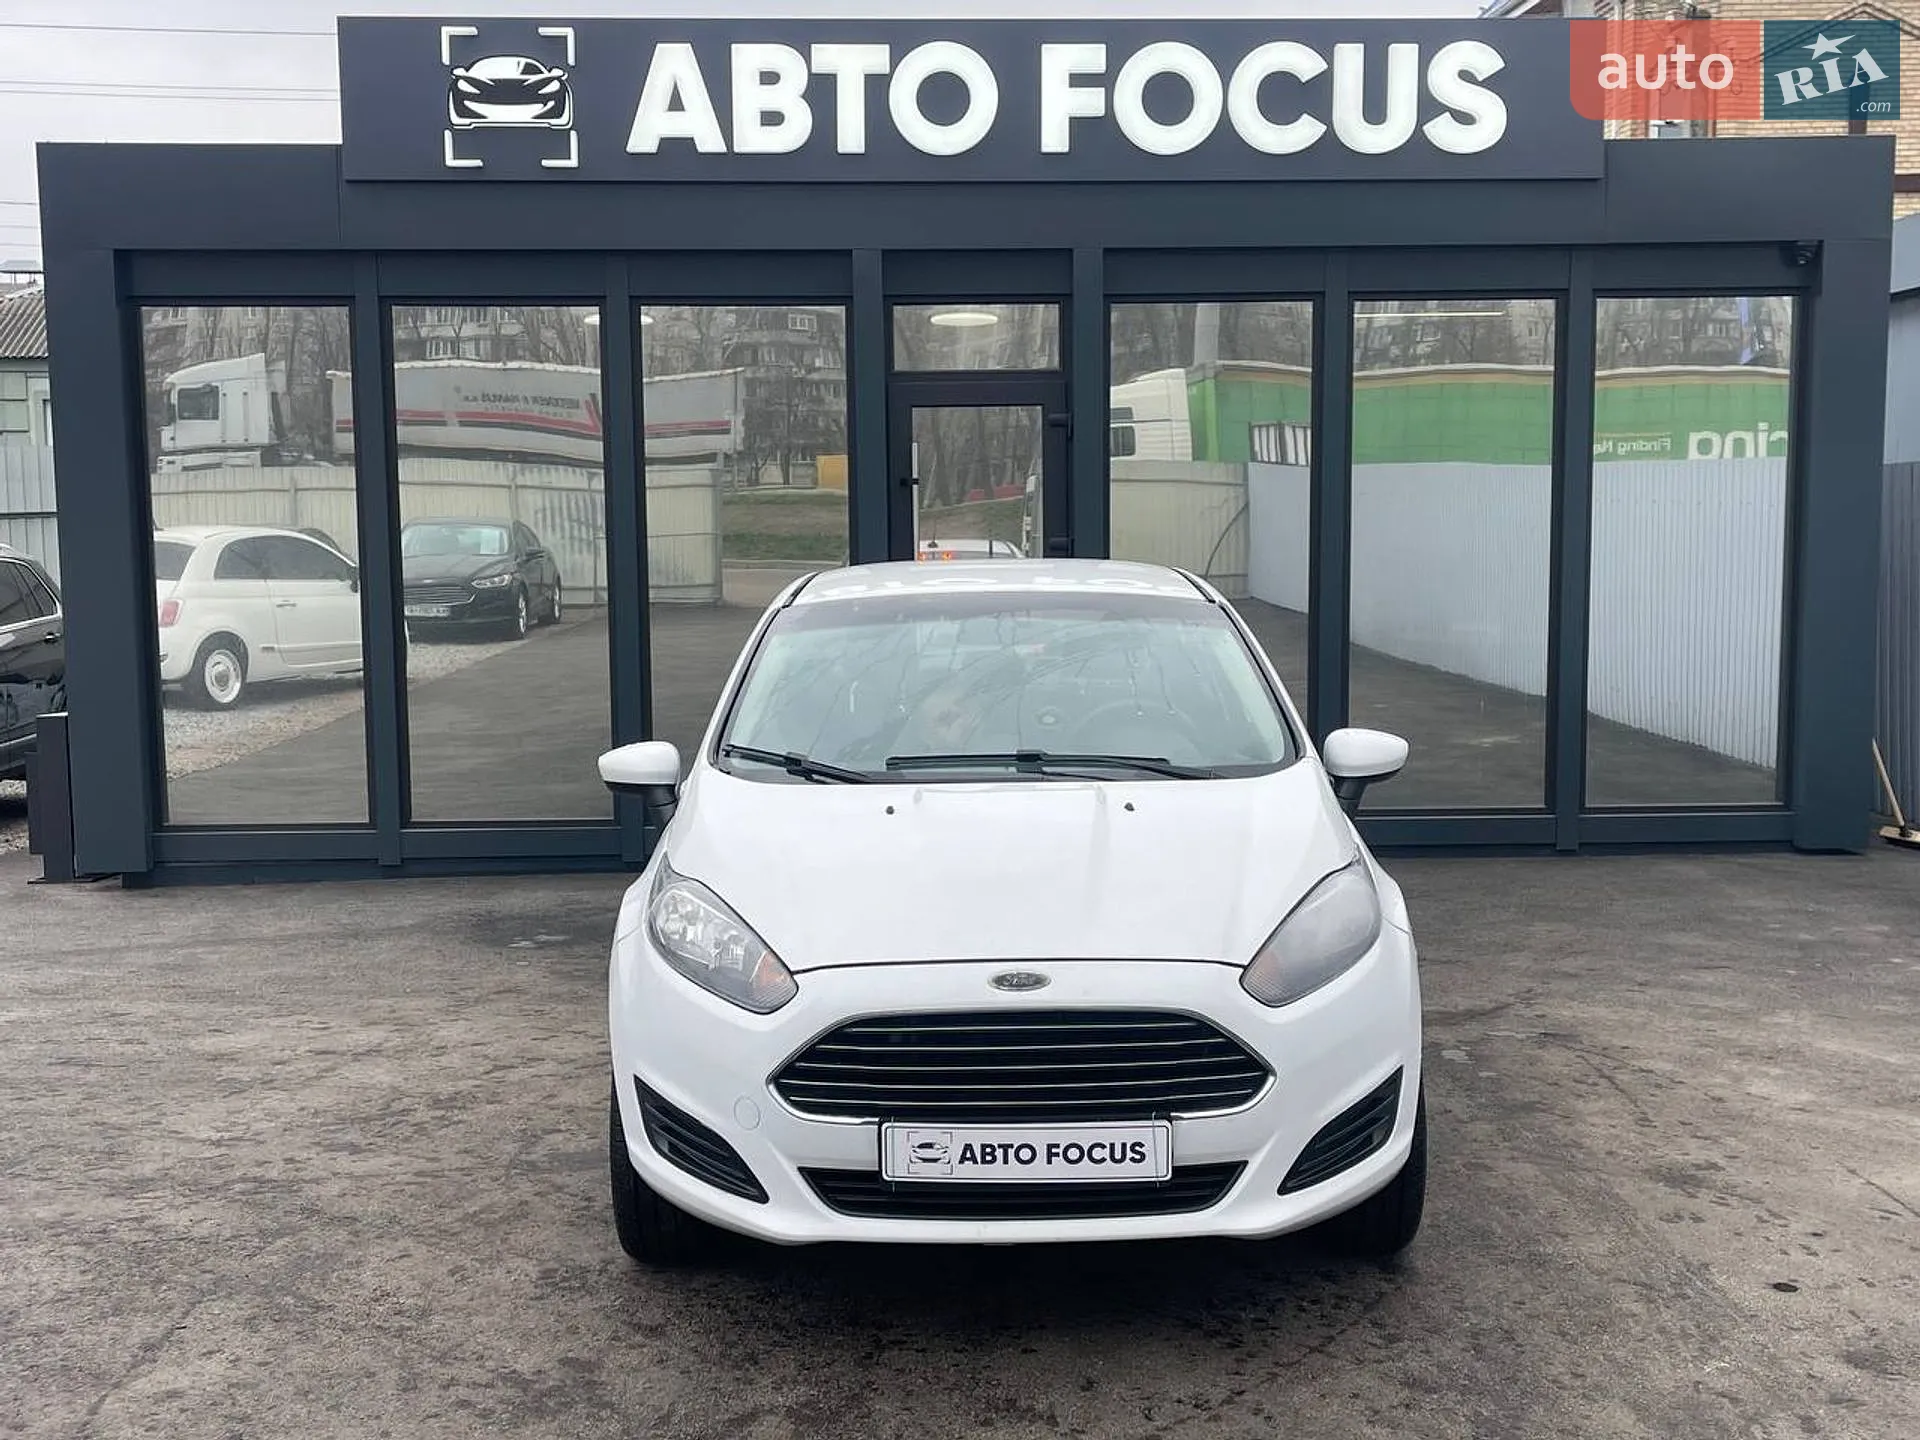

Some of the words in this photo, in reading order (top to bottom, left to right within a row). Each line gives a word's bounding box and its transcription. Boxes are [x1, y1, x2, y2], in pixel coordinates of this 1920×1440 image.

[625, 41, 999, 156] АВТО
[1040, 40, 1508, 156] FOCUS
[958, 1142, 1038, 1165] АВТО
[1046, 1141, 1147, 1165] FOCUS
